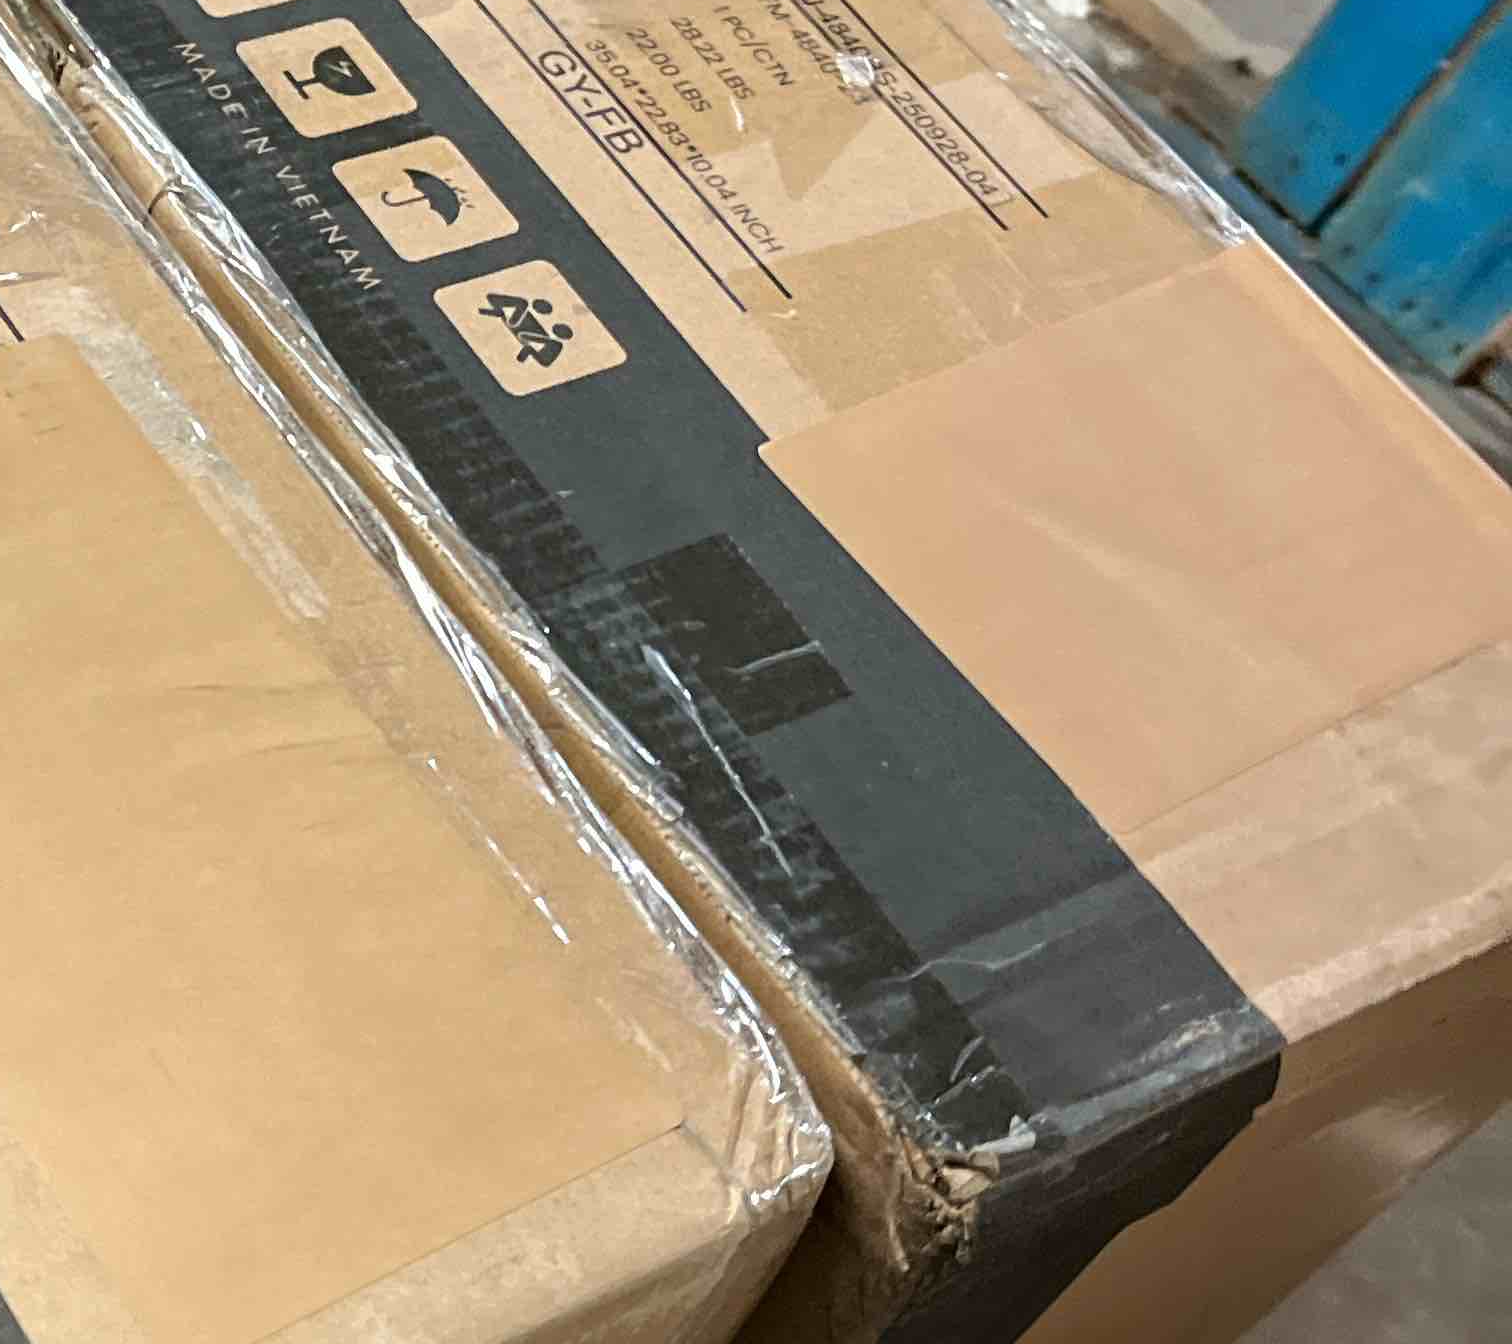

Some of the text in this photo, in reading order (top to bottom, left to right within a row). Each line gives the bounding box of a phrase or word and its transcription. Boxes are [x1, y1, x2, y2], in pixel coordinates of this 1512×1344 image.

[721, 13, 797, 88] PC/CTN
[537, 49, 645, 156] GY-FB
[673, 78, 713, 114] LBS
[715, 66, 756, 101] LBS
[173, 42, 383, 290] MADE IN VIETNAM
[733, 202, 785, 256] INCH
